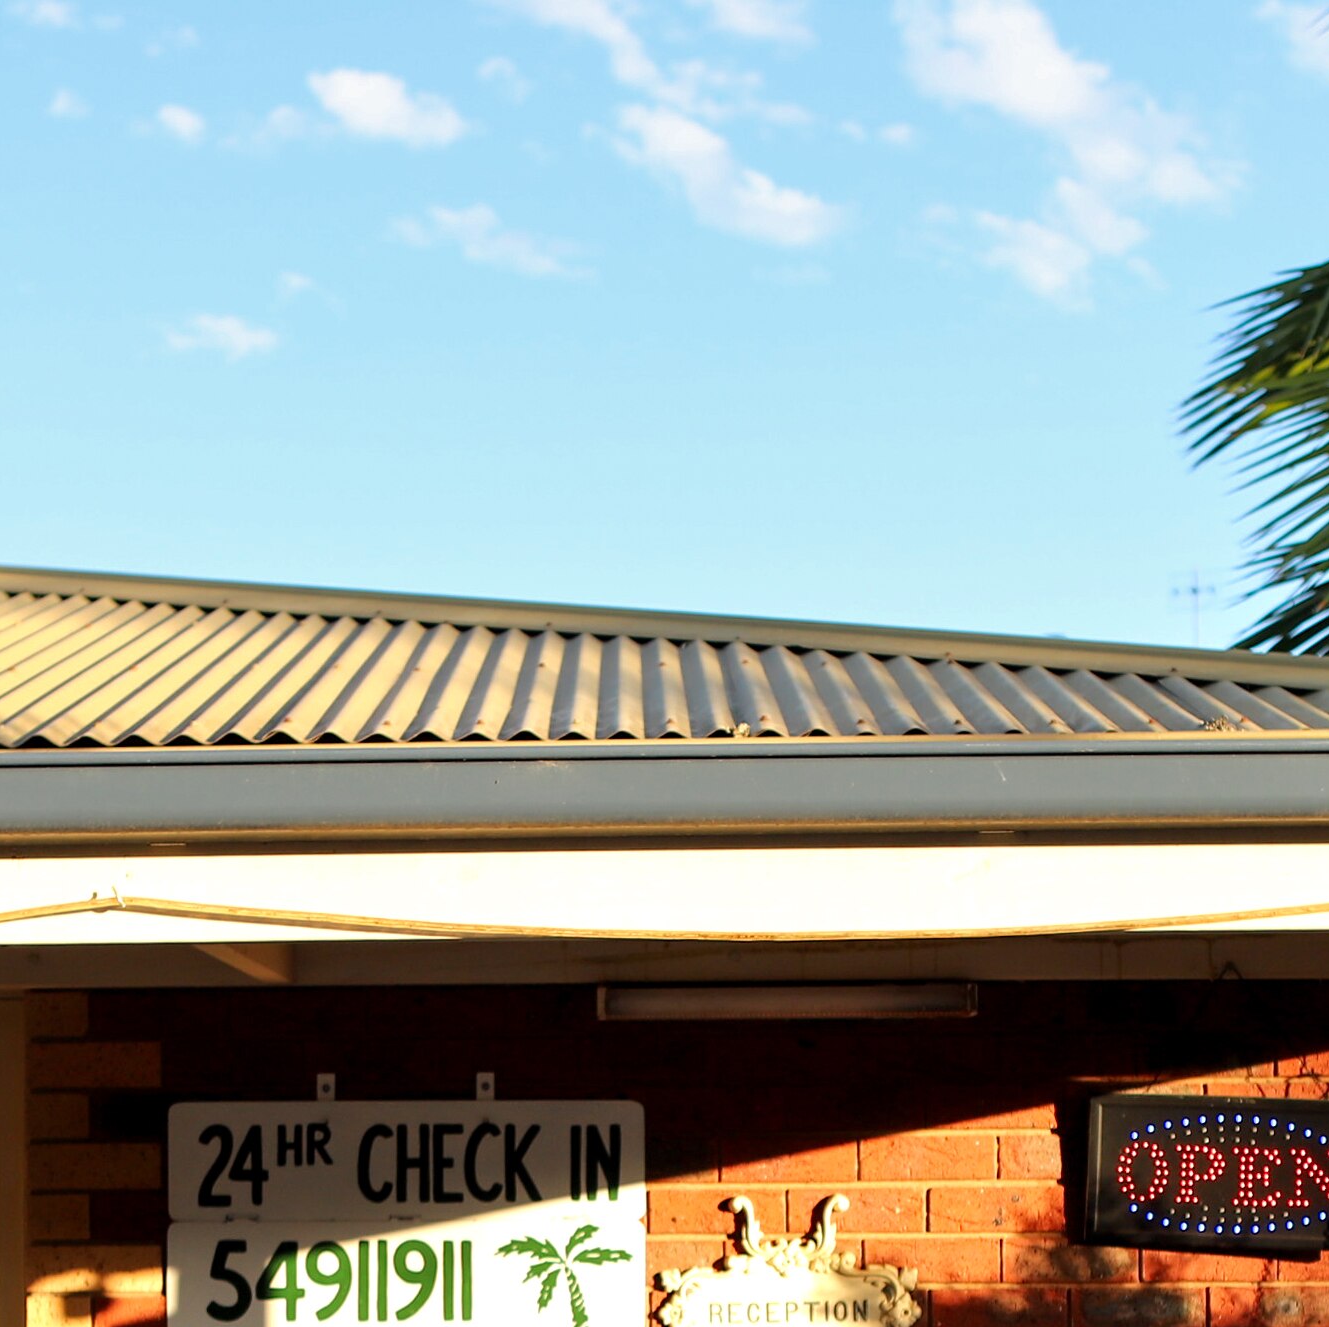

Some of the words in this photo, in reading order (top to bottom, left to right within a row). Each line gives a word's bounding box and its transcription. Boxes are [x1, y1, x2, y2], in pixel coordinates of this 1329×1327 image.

[358, 1122, 542, 1204] CHECK
[571, 1123, 622, 1202] IN
[207, 1239, 473, 1323] 54911911
[708, 1298, 870, 1325] RECEPTION
